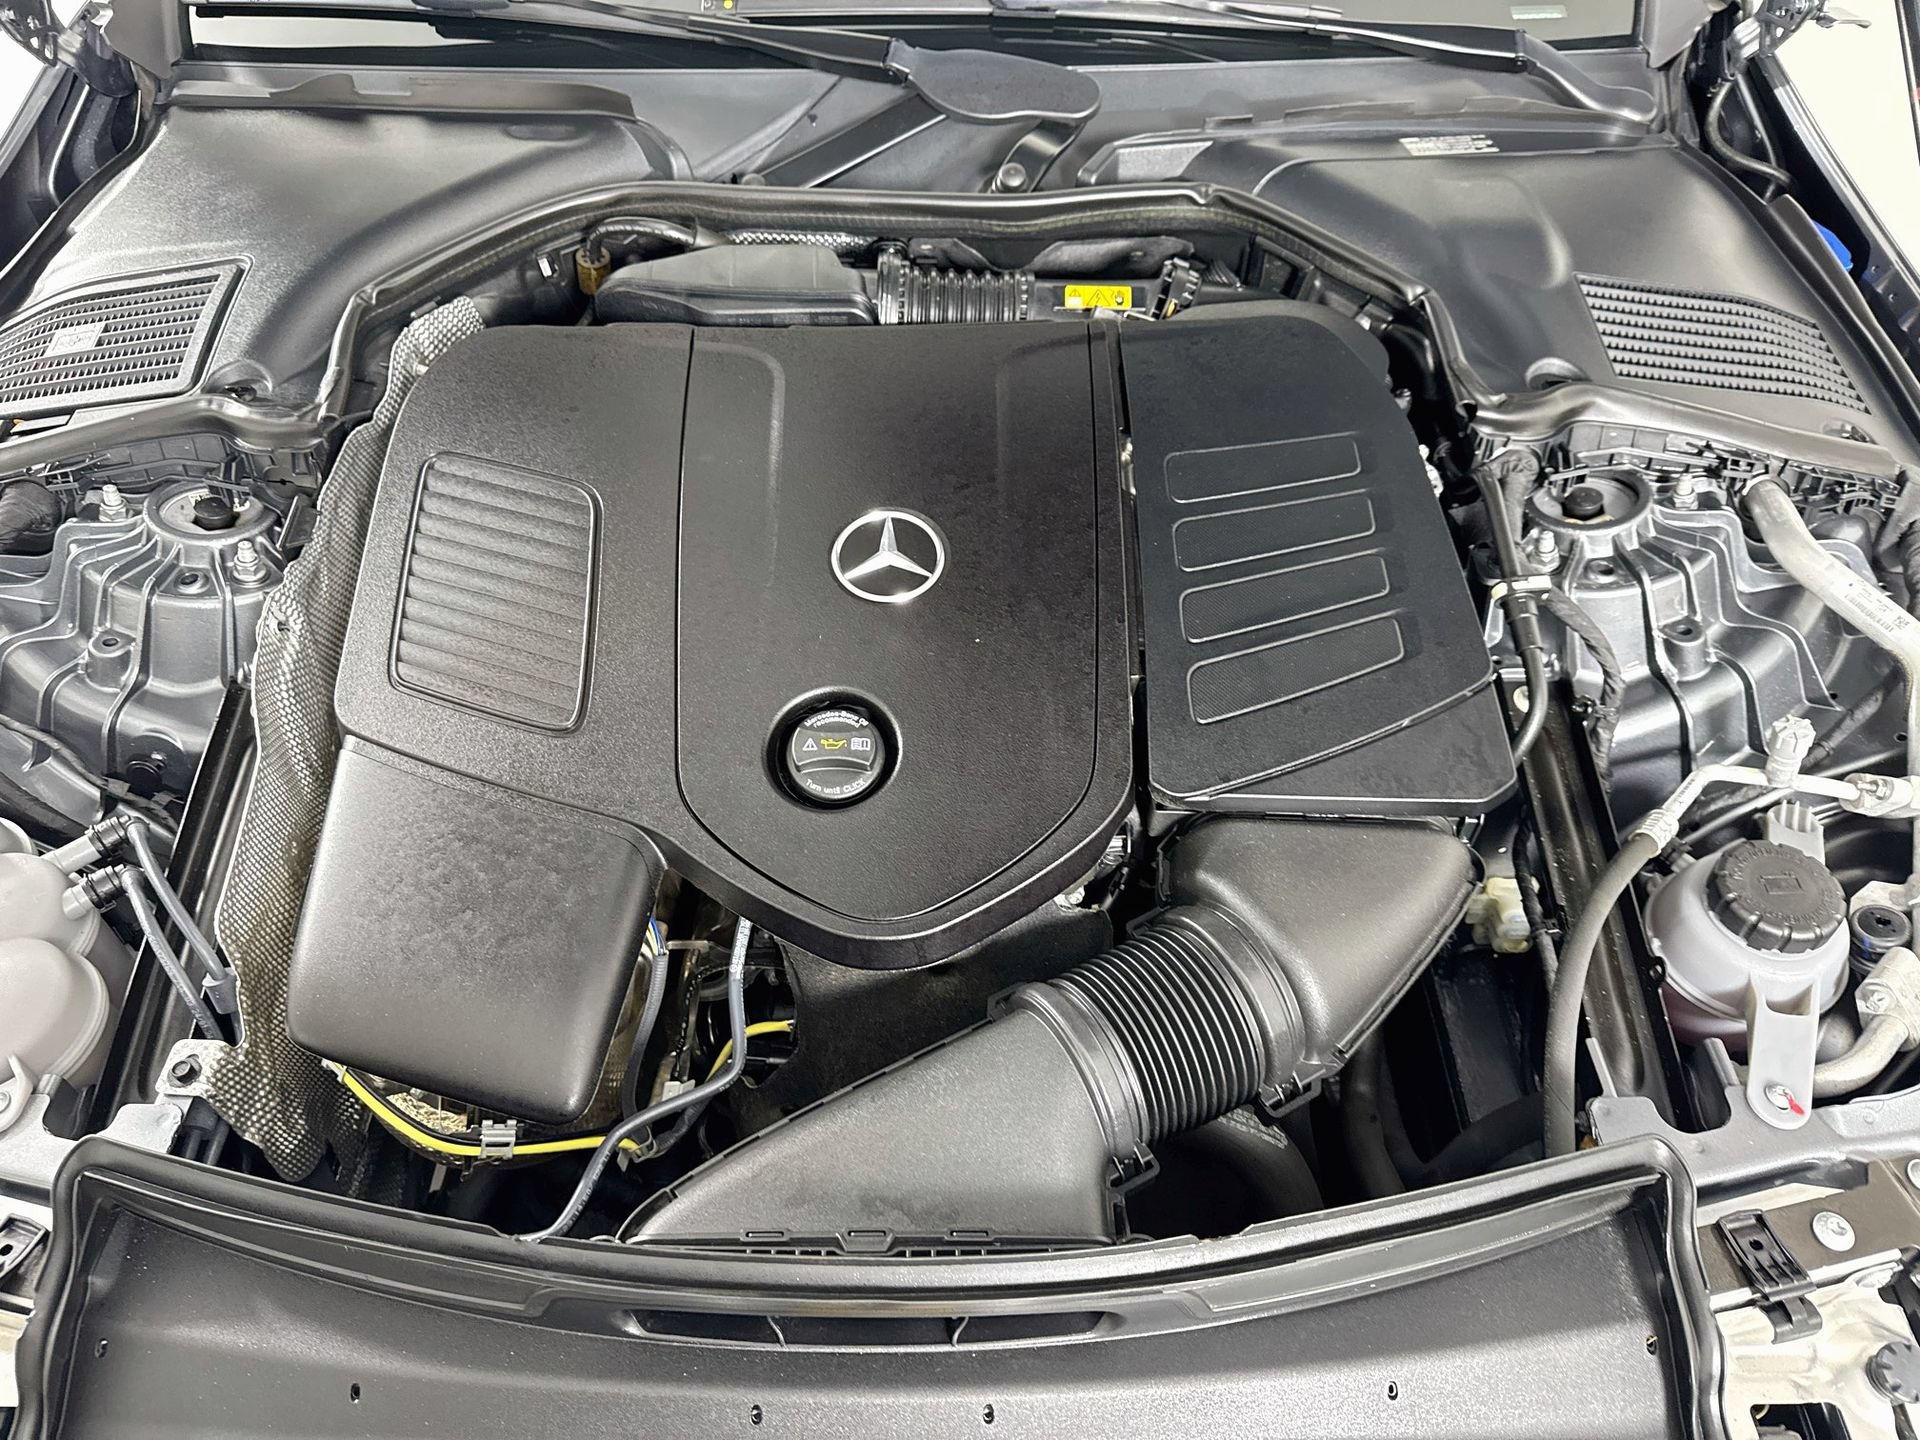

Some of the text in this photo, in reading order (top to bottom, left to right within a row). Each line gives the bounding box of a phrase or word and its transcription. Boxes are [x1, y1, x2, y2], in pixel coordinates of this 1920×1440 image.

[804, 710, 859, 727] Mercedes-Benz
[813, 716, 860, 729] recommended
[805, 777, 866, 795] Turn until CLICK
